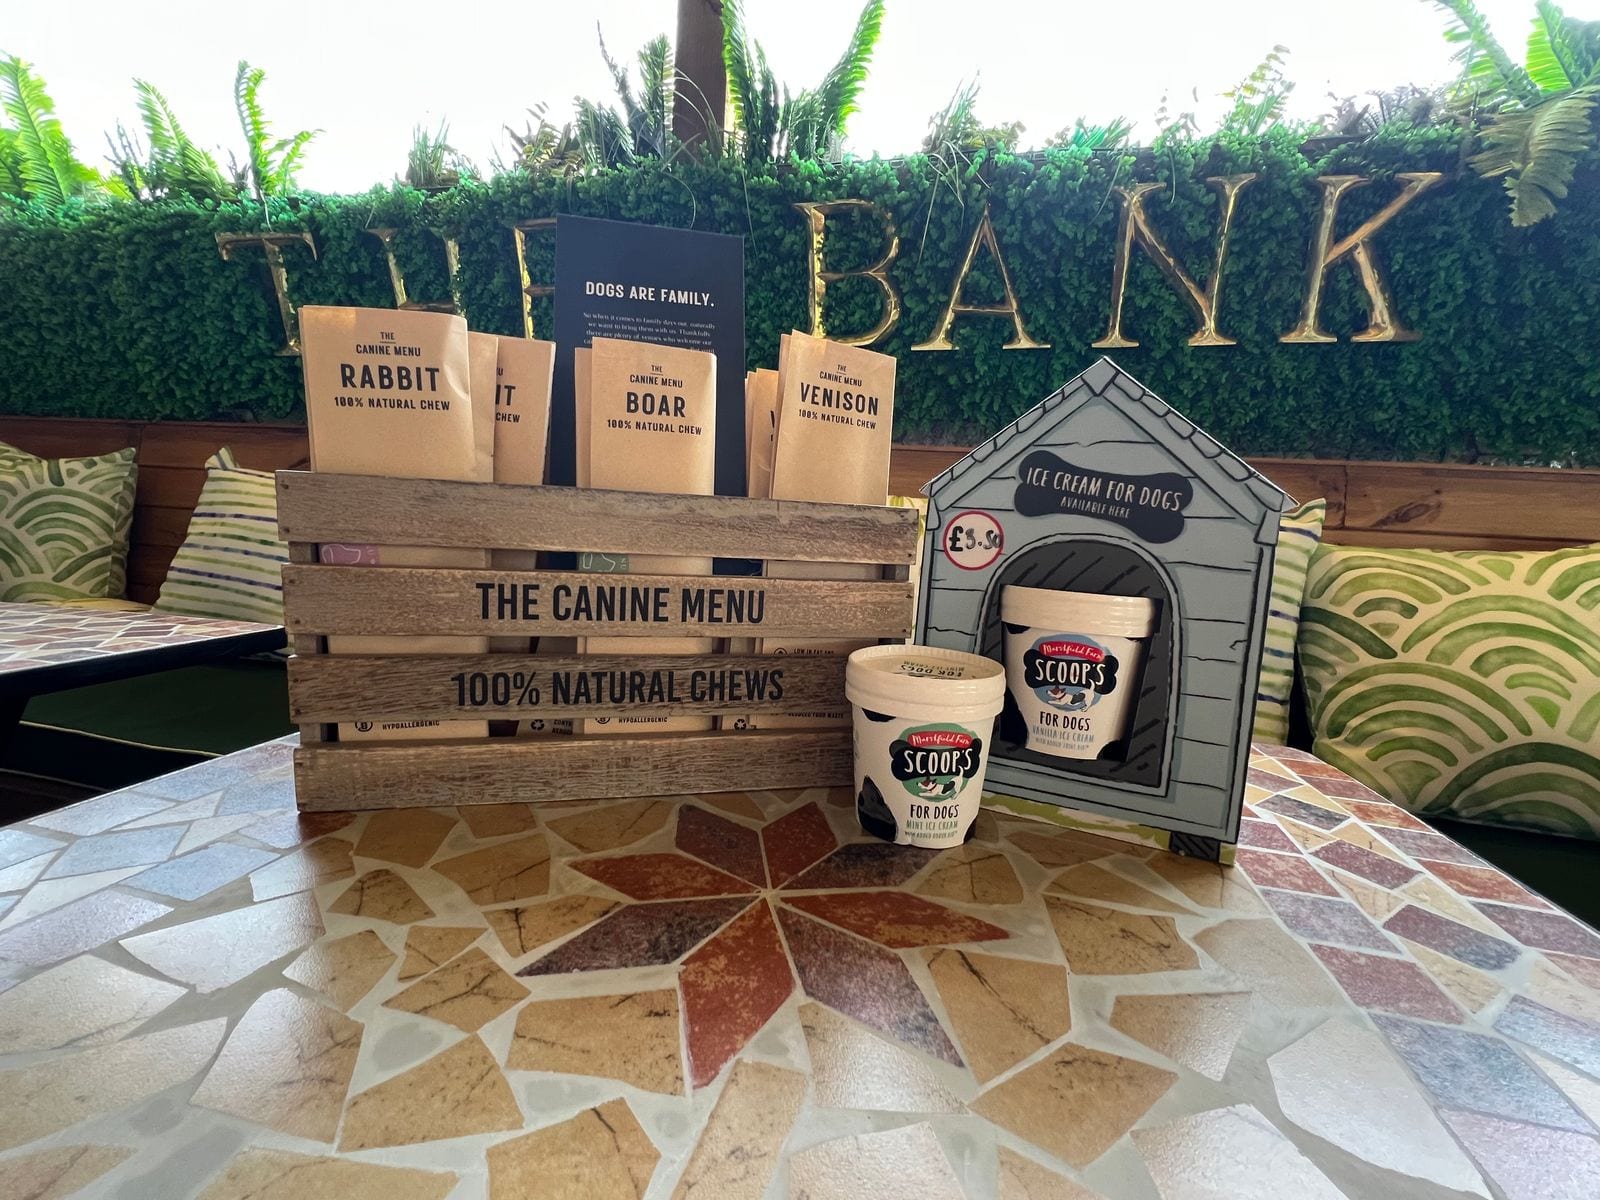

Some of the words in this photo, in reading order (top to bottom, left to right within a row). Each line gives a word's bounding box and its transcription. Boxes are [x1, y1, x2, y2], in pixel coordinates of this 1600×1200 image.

[793, 171, 1443, 351] BANK
[585, 281, 625, 298] DOGS
[629, 285, 656, 301] ARE
[660, 289, 715, 307] FAMILY.
[643, 317, 661, 326] family
[380, 332, 395, 340] THE
[356, 344, 391, 355] CANINE
[394, 346, 421, 357] MENU
[651, 364, 663, 373] THE
[837, 364, 847, 372] THE
[340, 363, 440, 392] RABBIT
[630, 374, 658, 386] CANINE
[661, 378, 683, 388] MENU
[819, 371, 842, 384] CANINE
[844, 376, 862, 387] MENU
[334, 396, 364, 407] 100%
[368, 398, 416, 410] NATURAL
[420, 400, 450, 411] CHEW
[626, 391, 686, 418] BOAR
[800, 382, 879, 416] VENISON
[496, 412, 521, 423] CHEW
[799, 408, 818, 420] 100%
[821, 413, 854, 425] NATURAL
[856, 419, 876, 430] CHEW
[607, 419, 632, 430] 100%
[635, 421, 675, 433] NATURAL
[678, 425, 702, 435] CHEW
[1026, 467, 1050, 487] ICE
[1053, 472, 1102, 497] CREAM
[1106, 480, 1136, 504] FOR
[1139, 486, 1183, 512] DOGS
[1060, 496, 1107, 514] AVAILABLE
[1108, 506, 1130, 519] HERE
[475, 583, 540, 621] THE
[552, 584, 670, 623] CANINE
[681, 588, 765, 624] MENU
[1035, 659, 1106, 686] SCOOP'S
[451, 671, 541, 707] 100%
[552, 670, 682, 704] NATURAL
[689, 669, 784, 702] CHEWS
[382, 720, 440, 730] HYPOALLERGENIC
[618, 716, 668, 724] HYPOALLERGENIC
[1040, 711, 1059, 727] FOR
[1063, 716, 1091, 732] DOGS
[912, 734, 955, 746] Marshfield
[1032, 725, 1057, 739] VANILLA
[1060, 731, 1070, 741] ICE
[1073, 733, 1094, 743] CREAM
[904, 748, 973, 774] SCOOP'S
[910, 804, 929, 819] FOR
[934, 804, 959, 819] DOGS
[907, 820, 923, 830] MINT
[926, 821, 936, 830] ICE
[938, 821, 959, 830] CREAM
